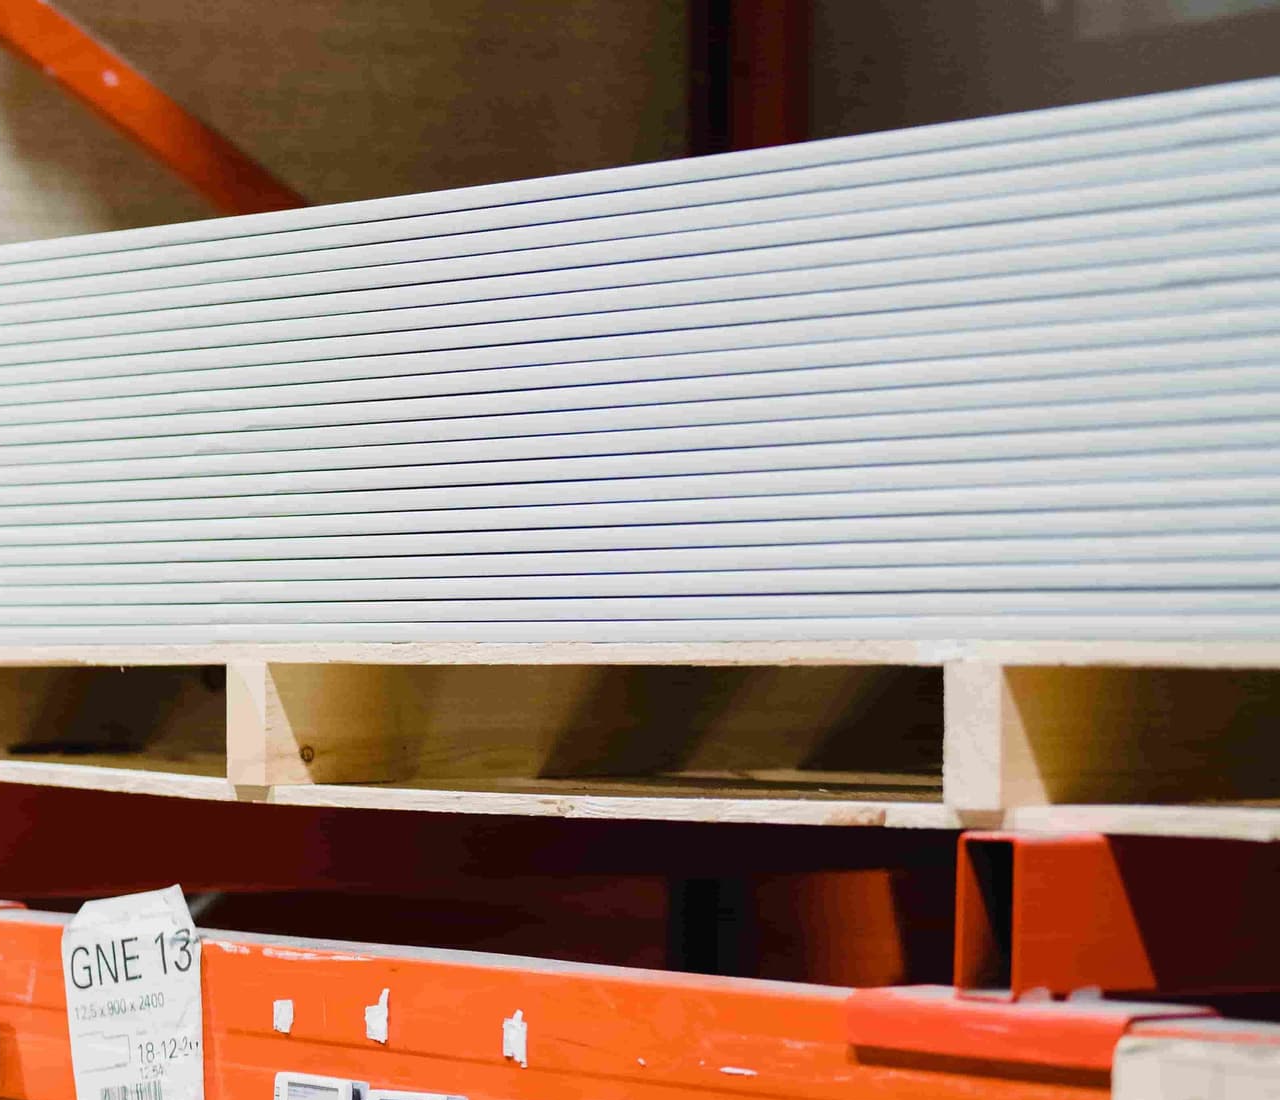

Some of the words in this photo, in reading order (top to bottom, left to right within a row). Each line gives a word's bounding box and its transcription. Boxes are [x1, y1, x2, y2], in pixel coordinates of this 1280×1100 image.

[70, 936, 142, 990] GNE
[154, 928, 192, 973] 13
[107, 998, 127, 1015] 900
[139, 991, 165, 1012] 2400
